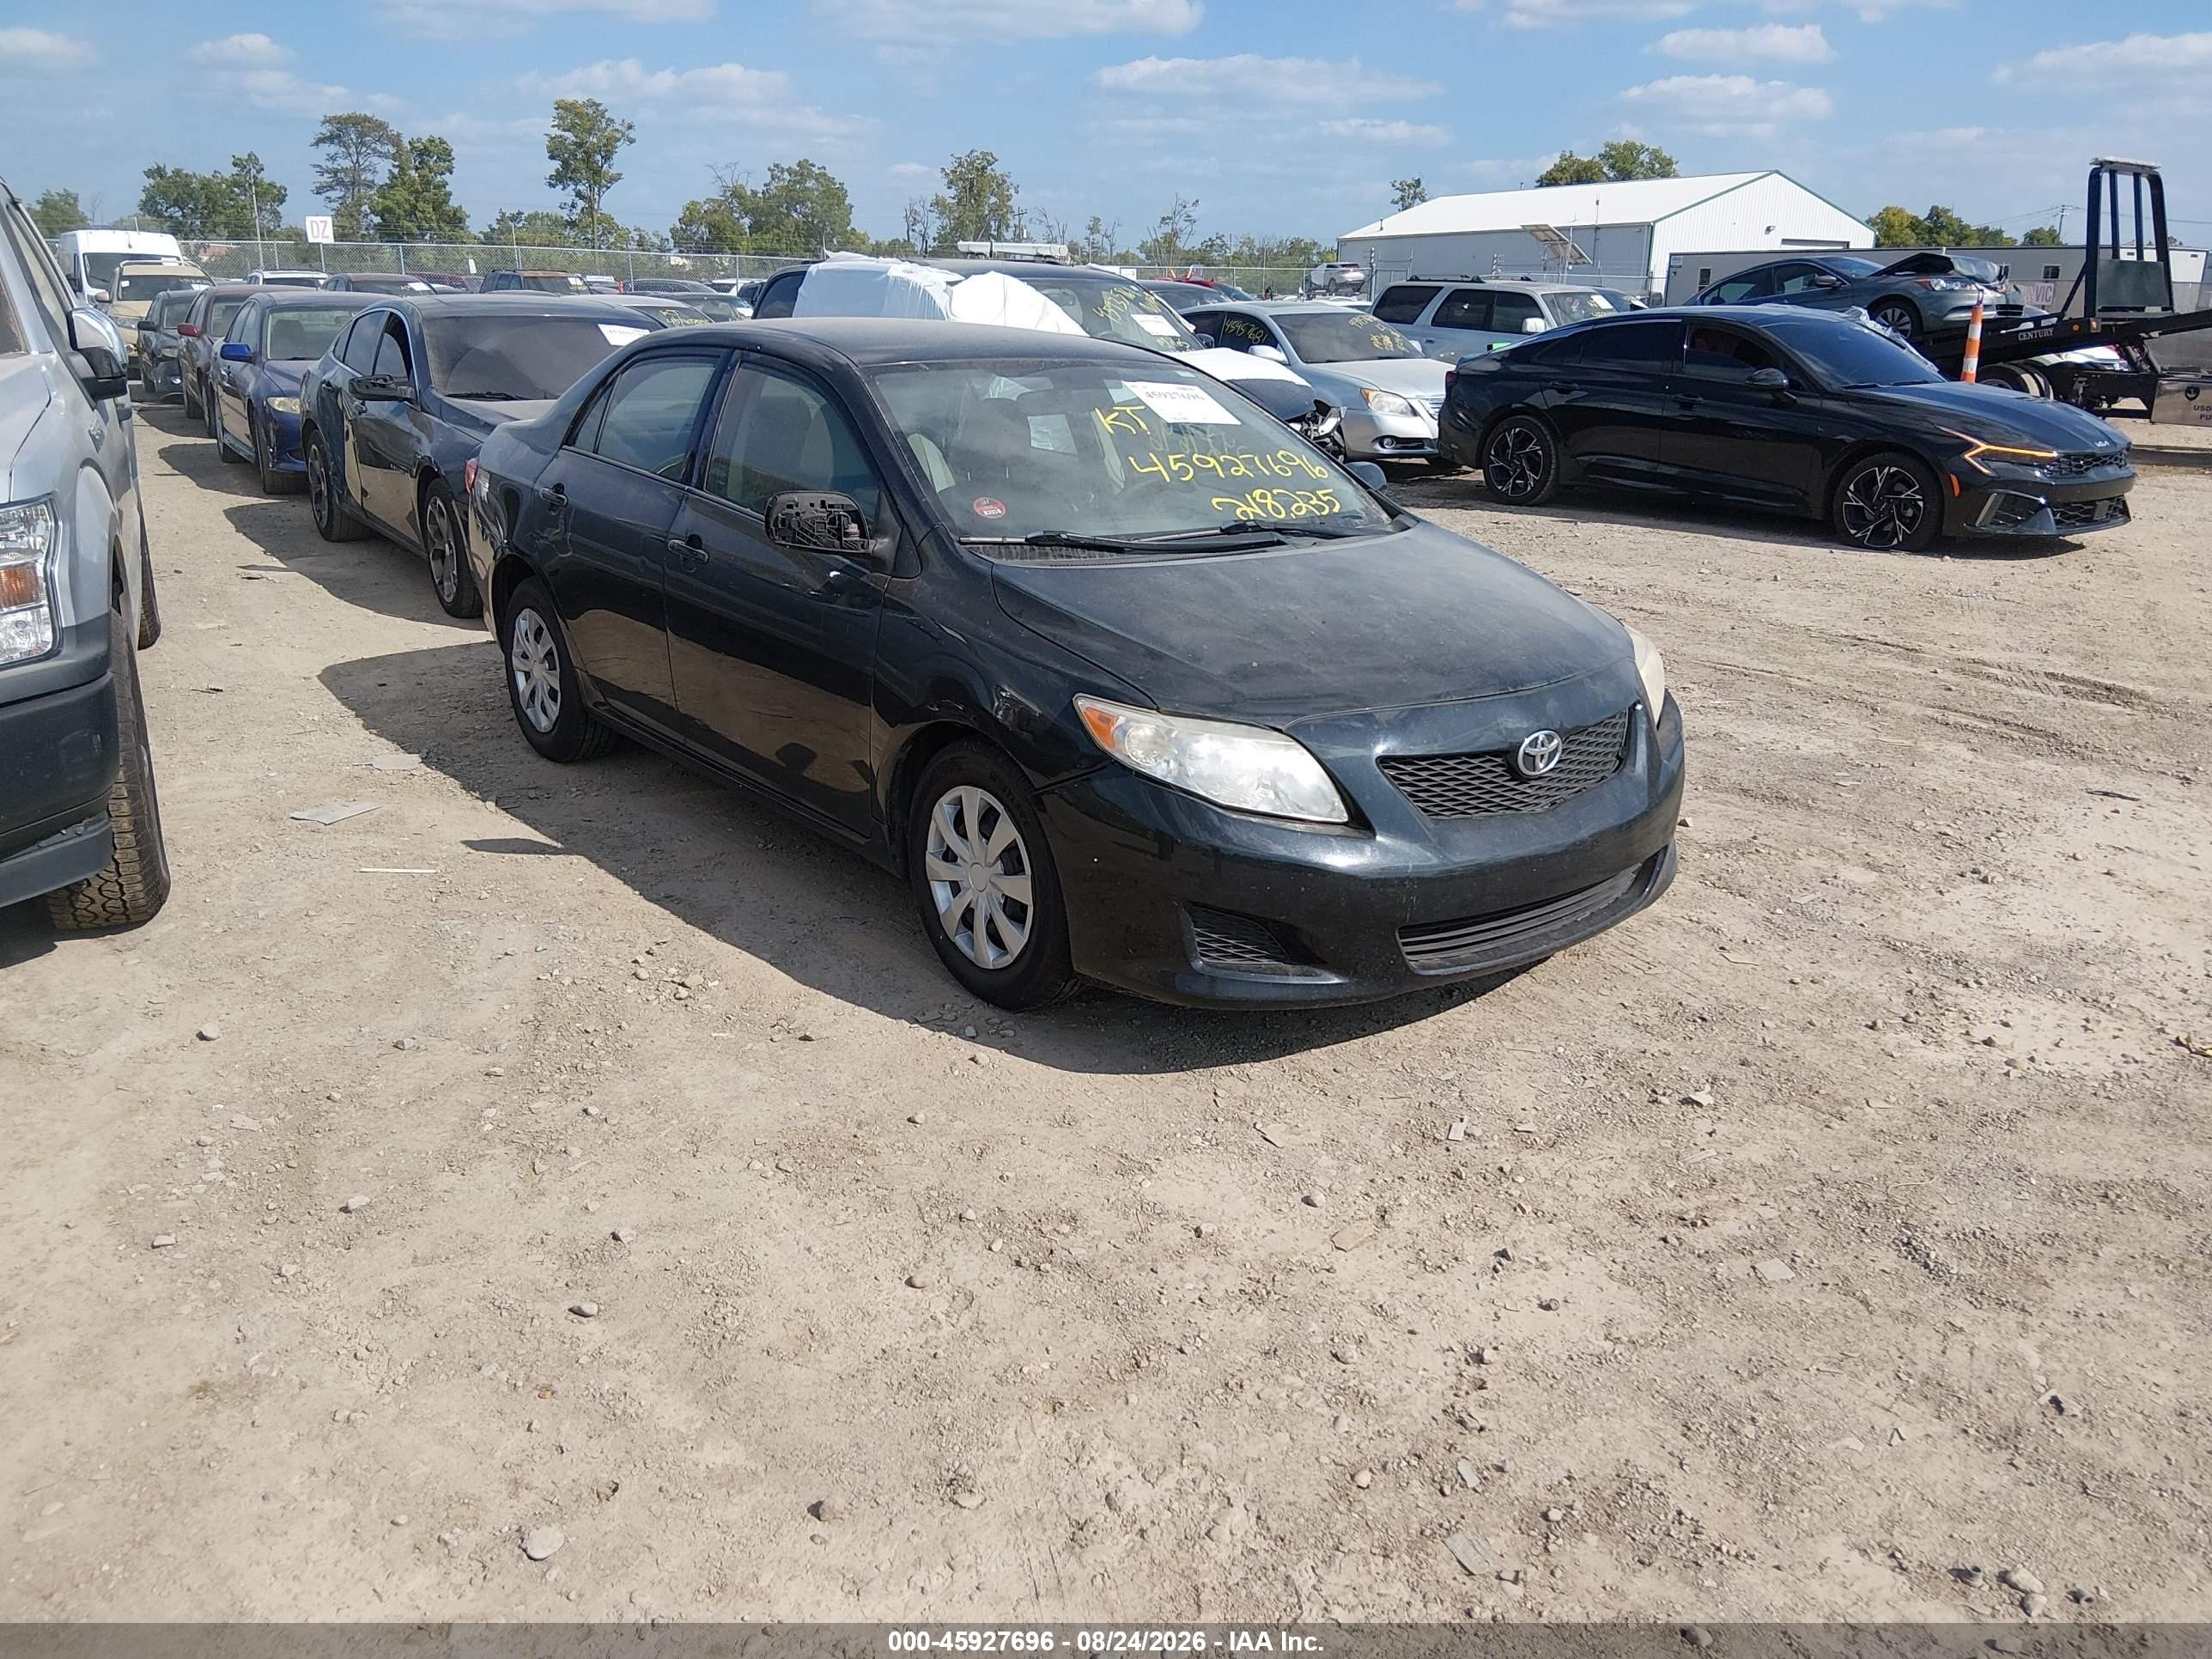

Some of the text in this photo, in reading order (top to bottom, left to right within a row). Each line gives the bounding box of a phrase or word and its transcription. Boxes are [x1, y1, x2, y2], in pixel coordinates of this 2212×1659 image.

[309, 220, 330, 239] DZ
[2034, 285, 2052, 303] VIC
[2018, 328, 2054, 341] CENTURY
[1127, 450, 1328, 483] 45927696
